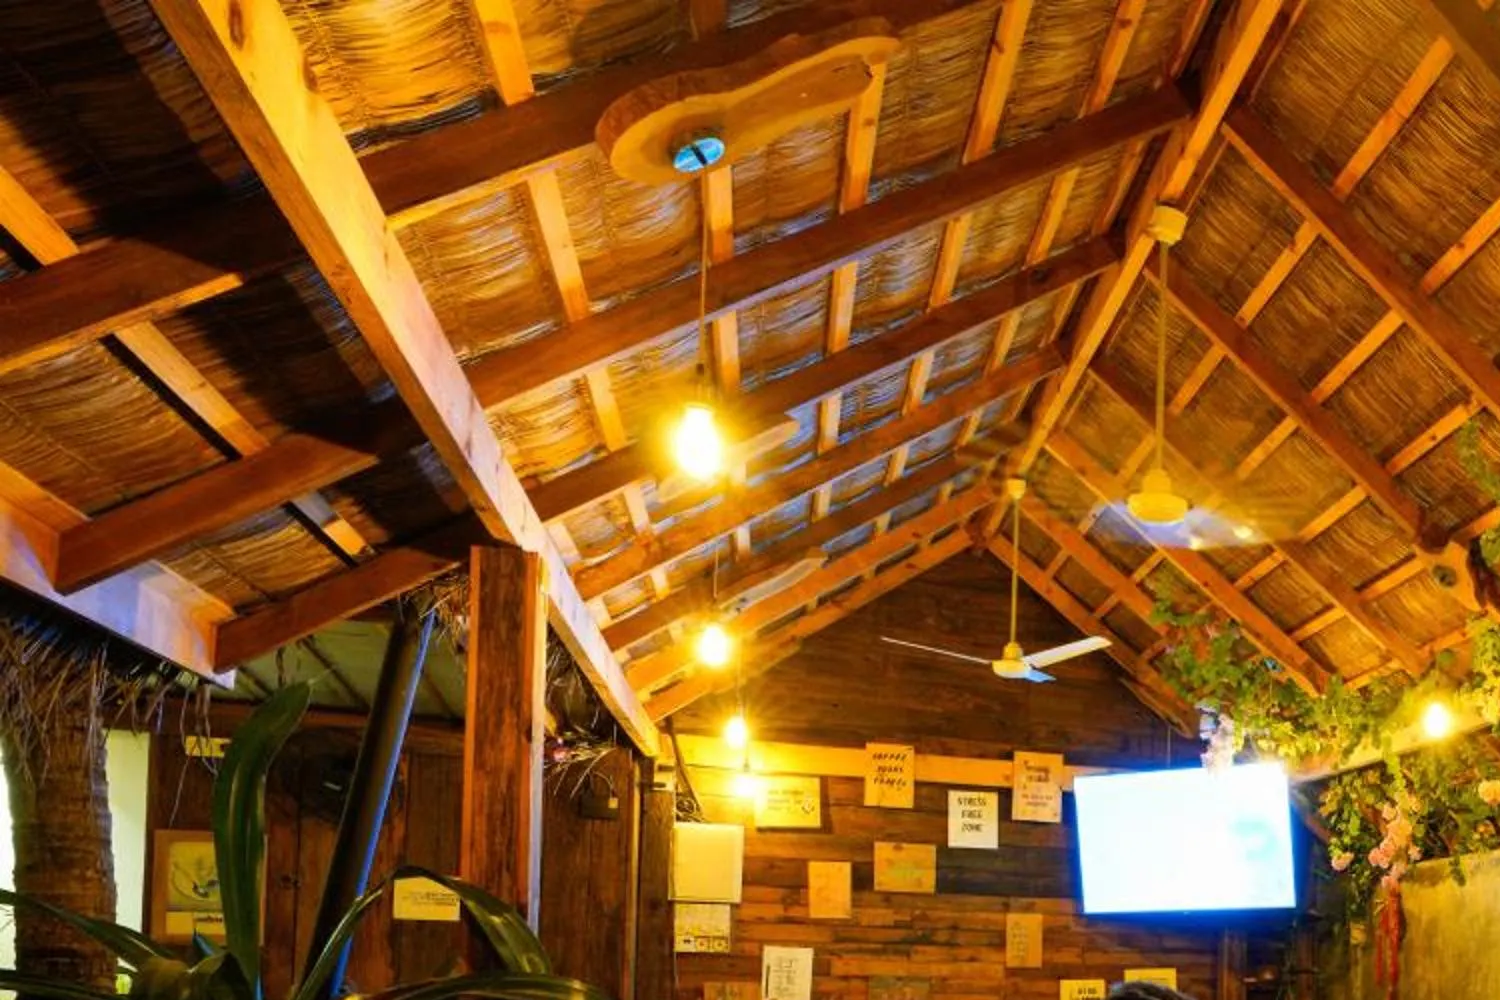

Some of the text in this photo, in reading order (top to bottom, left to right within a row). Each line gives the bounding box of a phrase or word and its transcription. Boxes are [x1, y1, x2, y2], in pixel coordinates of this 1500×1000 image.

[957, 796, 987, 806] STRESS
[961, 809, 983, 818] FREE
[961, 823, 983, 832] ZONE
